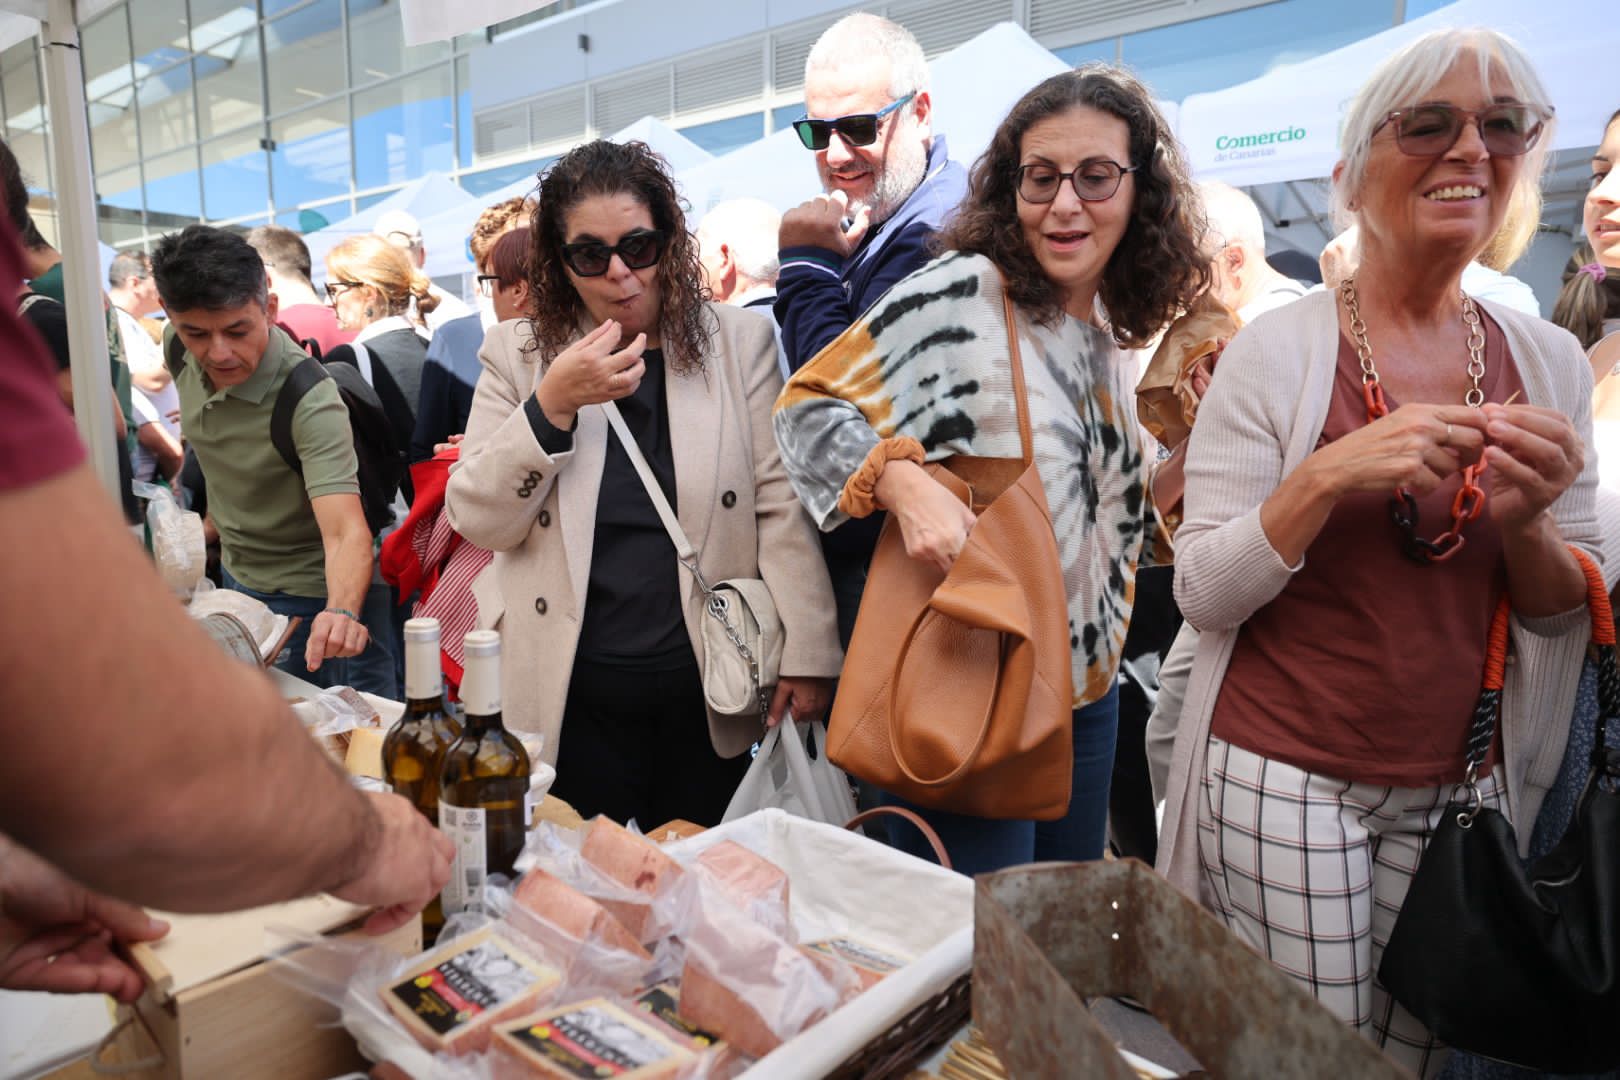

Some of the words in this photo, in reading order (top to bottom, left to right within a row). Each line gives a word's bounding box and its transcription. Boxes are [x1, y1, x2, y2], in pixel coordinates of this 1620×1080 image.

[1215, 126, 1307, 151] Comercio
[1214, 153, 1227, 162] de
[1229, 147, 1276, 161] Canarias
